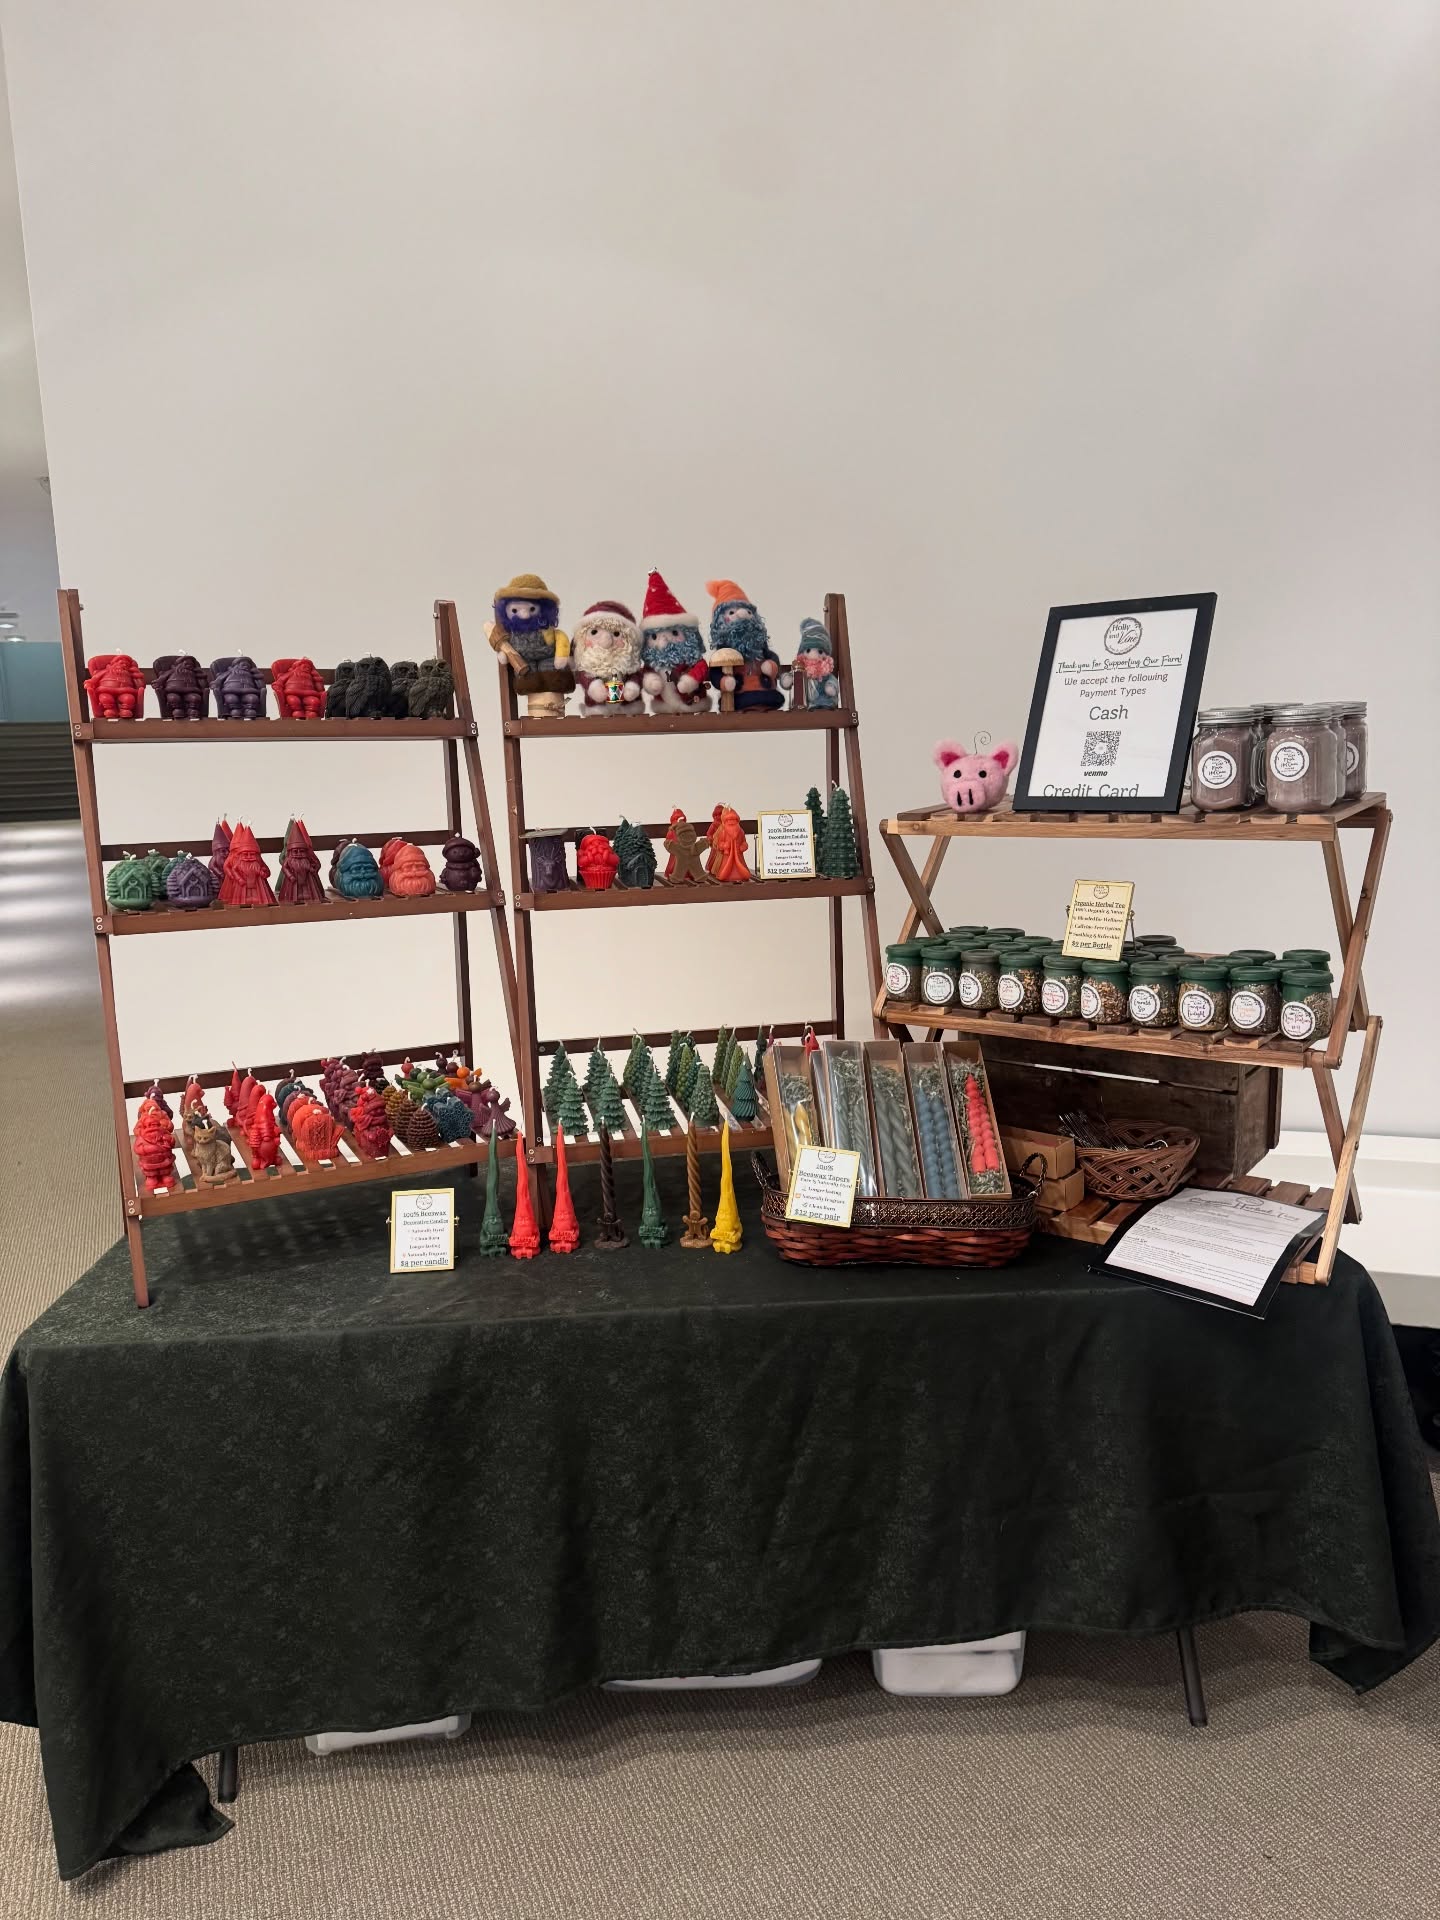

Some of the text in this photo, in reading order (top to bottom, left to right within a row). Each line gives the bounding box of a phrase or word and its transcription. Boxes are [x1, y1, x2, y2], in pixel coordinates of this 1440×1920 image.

[1118, 630, 1138, 644] Vine
[1058, 654, 1183, 673] Thank you for Supporting Our Farm!
[1064, 672, 1168, 686] We accept the following
[1080, 688, 1146, 699] Payment Types
[1089, 705, 1129, 721] Cash
[1043, 784, 1139, 797] Credit Card
[798, 1170, 850, 1183] Beeswax Tapers
[809, 1211, 822, 1219] per
